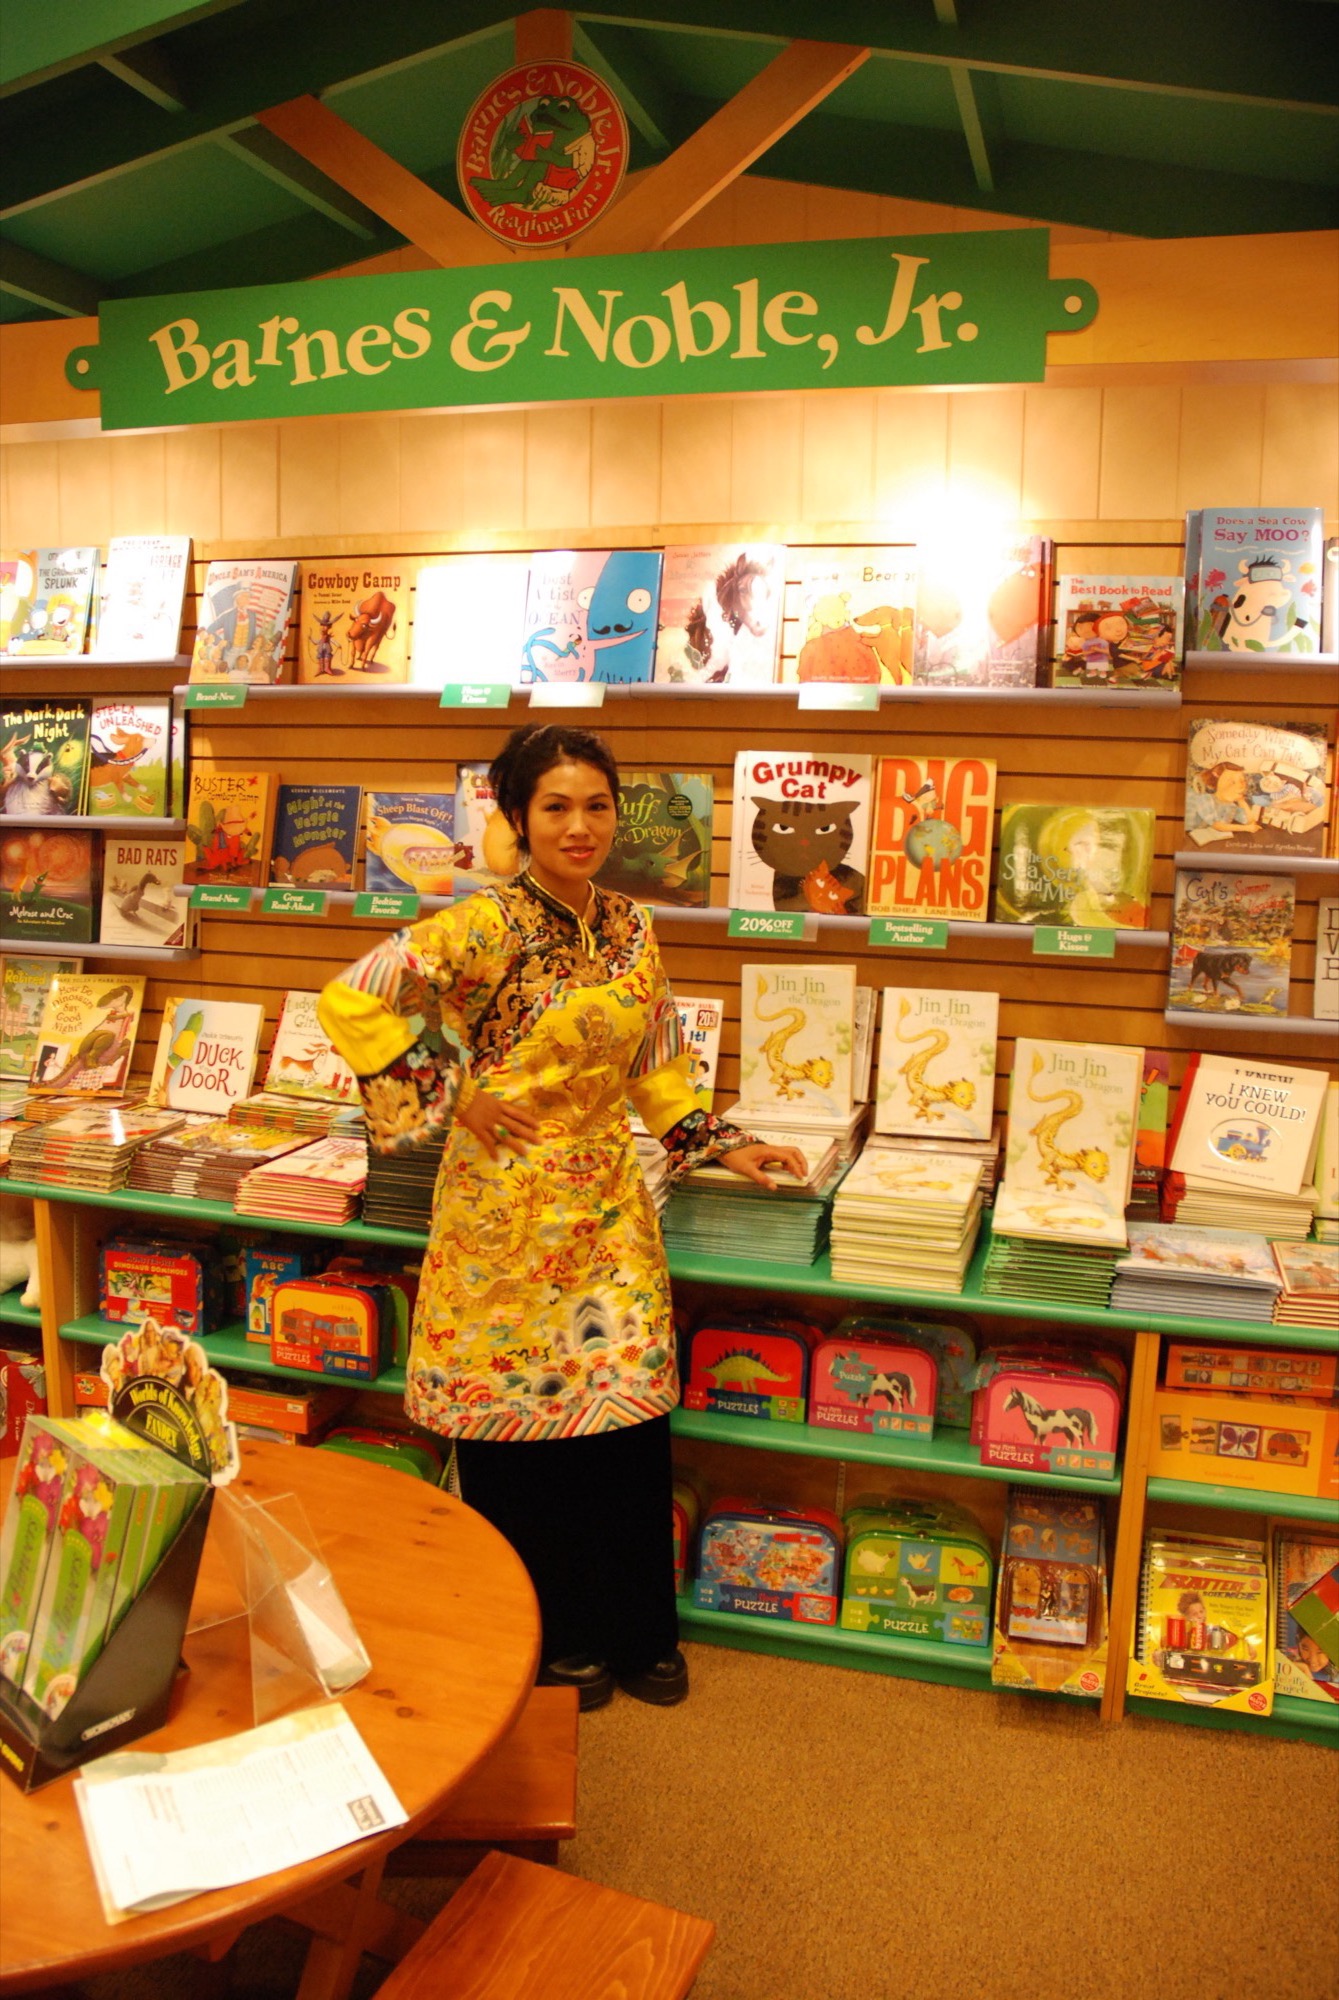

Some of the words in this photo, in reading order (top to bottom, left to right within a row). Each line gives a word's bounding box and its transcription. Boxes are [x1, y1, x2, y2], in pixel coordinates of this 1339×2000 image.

[466, 86, 521, 173] Barnes
[526, 69, 546, 95] &
[487, 206, 564, 238] Reading
[563, 193, 598, 227] Fun
[148, 305, 431, 395] Barnes
[450, 290, 530, 372] &
[544, 277, 840, 370] Noble,
[854, 252, 979, 354] Jr.
[1216, 516, 1244, 526] Does
[1258, 516, 1278, 526] Sea
[1283, 517, 1307, 526] Cow
[1214, 528, 1248, 544] Say
[1255, 528, 1310, 542] MOO?
[256, 566, 288, 582] AMERICA
[308, 572, 358, 592] Cowboy
[362, 572, 401, 590] Camp
[44, 577, 78, 590] SPLUNK
[1071, 584, 1096, 594] Best
[1100, 586, 1128, 595] Book
[1142, 586, 1172, 596] Read
[196, 692, 236, 702] Brand-New
[3, 713, 22, 728] The
[24, 704, 54, 724] Dark,
[56, 704, 84, 722] Dark
[34, 724, 69, 742] Night
[100, 716, 162, 736] UNLEASHED
[1208, 725, 1259, 744] Someday
[1264, 729, 1296, 748] When
[1202, 746, 1222, 764] My
[1225, 744, 1248, 758] Cat
[1253, 744, 1276, 758] Can
[752, 760, 862, 788] Grumpy
[194, 776, 247, 794] BUSTER
[780, 779, 826, 800] Cat
[286, 796, 325, 816] Night
[377, 804, 404, 816] Sheep
[406, 804, 428, 814] Blast
[430, 808, 453, 823] Off!
[876, 759, 988, 857] BIG
[293, 811, 340, 830] Veggie
[292, 827, 347, 848] Monster
[624, 825, 682, 845] Dragon
[118, 847, 141, 865] BAD
[146, 848, 178, 866] RATS
[872, 854, 986, 911] PLANS
[200, 892, 240, 904] Brand-New
[282, 892, 304, 902] Great
[1042, 882, 1075, 903] Me
[1186, 878, 1228, 907] Carl's
[271, 901, 315, 912] Read-Aloud
[372, 896, 402, 906] Bedtime
[40, 908, 54, 918] and
[370, 905, 400, 915] Favorite
[870, 905, 890, 914] BOB
[892, 905, 918, 914] SHEA
[924, 908, 948, 917] LANE
[950, 909, 982, 918] SMITH
[739, 918, 774, 932] 20%
[774, 919, 794, 928] OFF
[885, 922, 934, 936] Bestselling
[891, 933, 925, 943] Author
[1058, 930, 1082, 942] Hugs
[1058, 941, 1090, 952] Kisses
[5, 970, 46, 986] Retired
[772, 974, 797, 994] Jin
[802, 976, 826, 996] Jin
[789, 994, 804, 1004] the
[806, 996, 841, 1008] Dragon
[915, 996, 942, 1016] Jin
[946, 998, 971, 1018] Jin
[56, 1012, 82, 1023] Good
[950, 1018, 986, 1029] Dragon
[195, 1041, 245, 1070] DUCK
[1048, 1052, 1075, 1074] Jin
[1080, 1056, 1108, 1078] Jin
[179, 1064, 238, 1097] DOOR
[1085, 1077, 1123, 1094] Dragon
[1229, 1082, 1234, 1095] I
[1240, 1086, 1289, 1104] KNEW
[1206, 1092, 1240, 1110] YOU
[1244, 1100, 1306, 1122] COULD!
[114, 1261, 150, 1272] DINOSAUR
[151, 1266, 188, 1276] DOMINOES
[261, 1262, 284, 1272] ABC
[276, 1350, 310, 1364] PUZZLES
[840, 1371, 866, 1382] Puzzle
[718, 1400, 758, 1414] PUZZLES
[817, 1411, 858, 1426] PUZZLES
[146, 1414, 178, 1448] FANDEX
[989, 1450, 1034, 1464] PUZZLES
[734, 1598, 778, 1614] PUZZLE
[884, 1618, 929, 1634] PUZZLE
